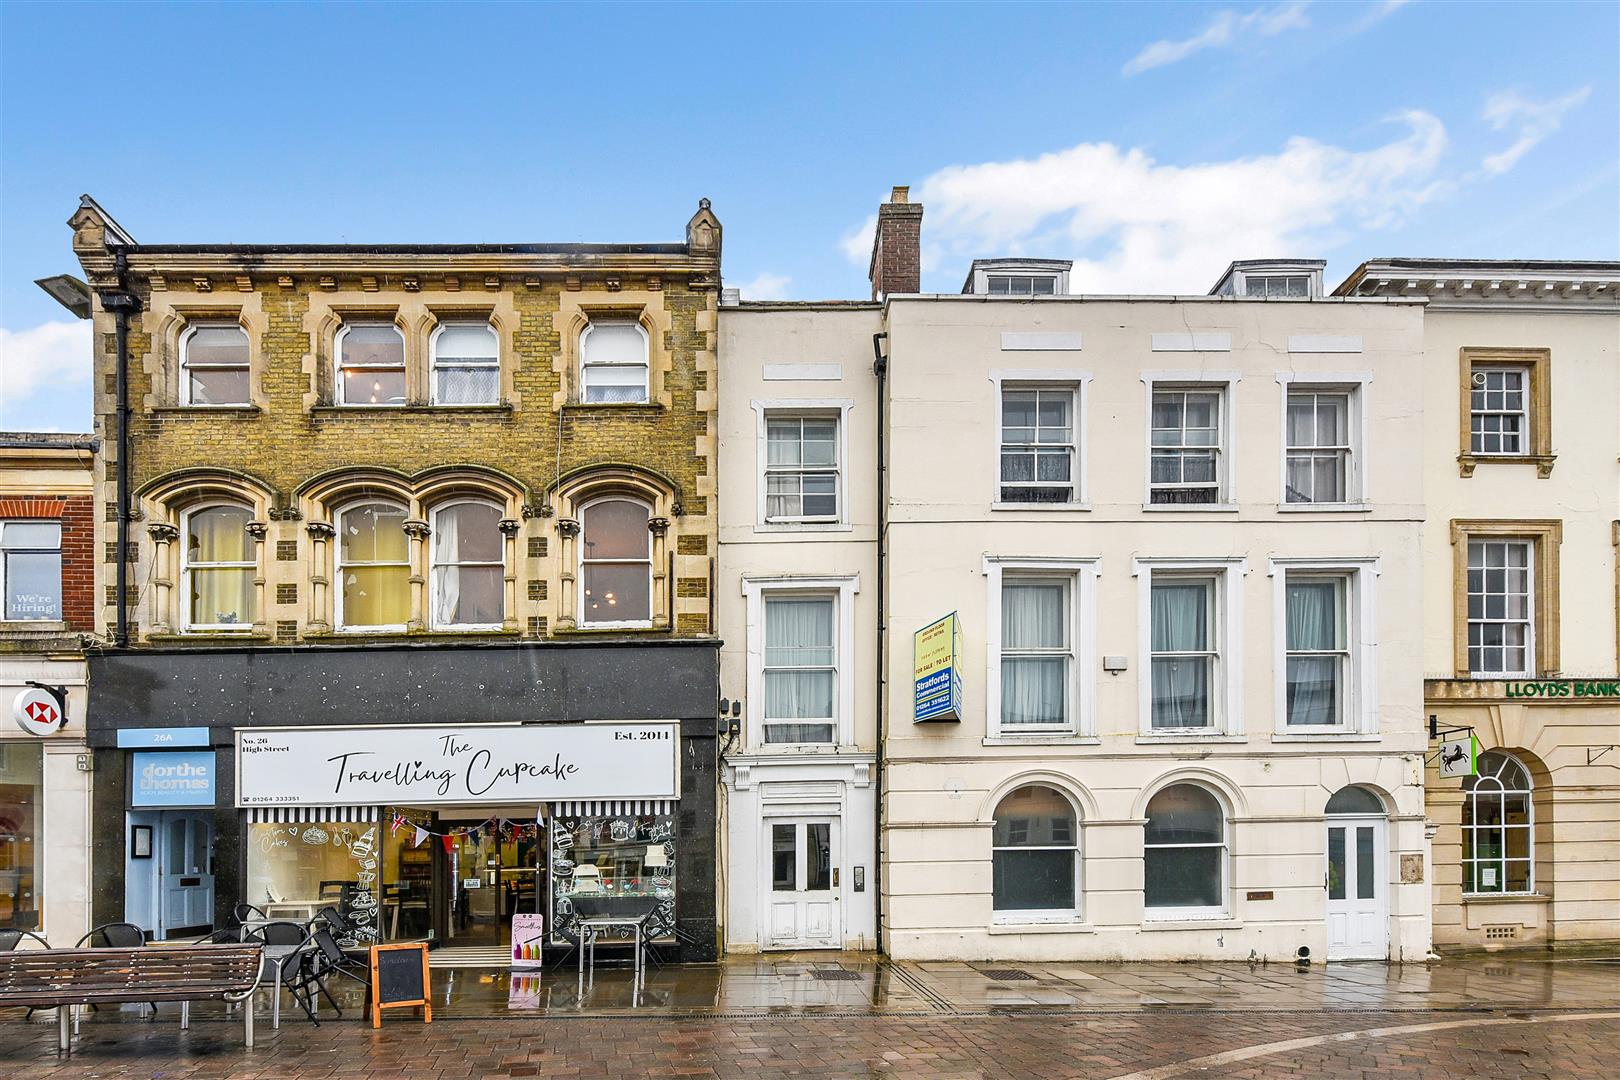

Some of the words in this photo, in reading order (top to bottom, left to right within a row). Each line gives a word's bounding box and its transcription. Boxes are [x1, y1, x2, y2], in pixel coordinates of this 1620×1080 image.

[16, 594, 52, 603] We're
[12, 604, 56, 615] Hiring!
[942, 655, 951, 663] LET
[916, 672, 950, 692] Stratfords
[916, 681, 950, 699] Commercial
[1505, 682, 1570, 697] LLOYDS
[1574, 682, 1620, 697] BANK
[154, 734, 172, 742] 26A
[614, 731, 637, 741] Est.
[639, 731, 669, 741] 2014
[242, 746, 262, 754] High
[439, 733, 474, 757] The
[143, 763, 207, 777] dorthe
[327, 751, 457, 796] Travelling
[466, 749, 580, 796] Cupcake
[140, 776, 209, 790] thomas
